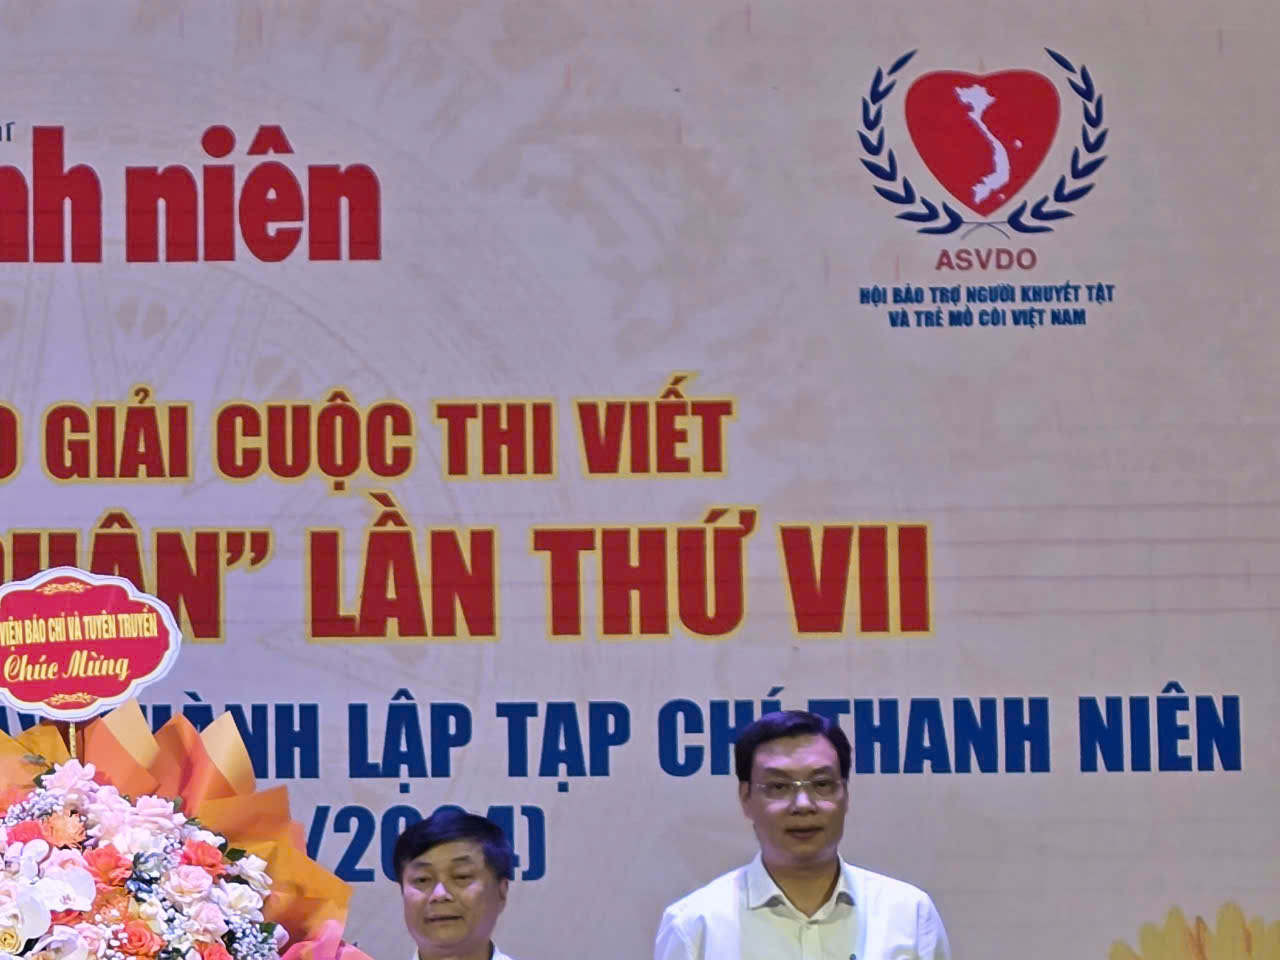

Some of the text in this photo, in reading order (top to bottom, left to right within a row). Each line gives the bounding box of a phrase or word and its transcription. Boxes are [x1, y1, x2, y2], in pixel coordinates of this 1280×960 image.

[125, 124, 381, 263] niên
[935, 248, 1038, 271] ASVDO
[859, 284, 888, 307] HỘI
[888, 307, 910, 328] VÀ
[1011, 306, 1046, 329] VIỆT
[1050, 308, 1087, 326] NAM
[42, 386, 191, 480] GIẢI
[216, 390, 414, 492] CUỘC
[434, 402, 553, 477] THI
[575, 375, 733, 476] VIẾT
[309, 492, 498, 640] LẦN
[531, 507, 756, 639] THỨ
[778, 523, 930, 634] VII
[0, 616, 24, 651] VIỆN
[25, 613, 47, 644] BÁO
[48, 611, 67, 643] CHÍ
[68, 611, 83, 641] VÀ
[83, 609, 116, 641] TUYÊN
[118, 605, 158, 639] TRUYỀN
[3, 649, 131, 683] Chúc Mừng
[348, 687, 473, 794] LẬP
[496, 700, 631, 793] TẠP
[658, 686, 784, 778] CH
[1079, 681, 1242, 772] NIÊN
